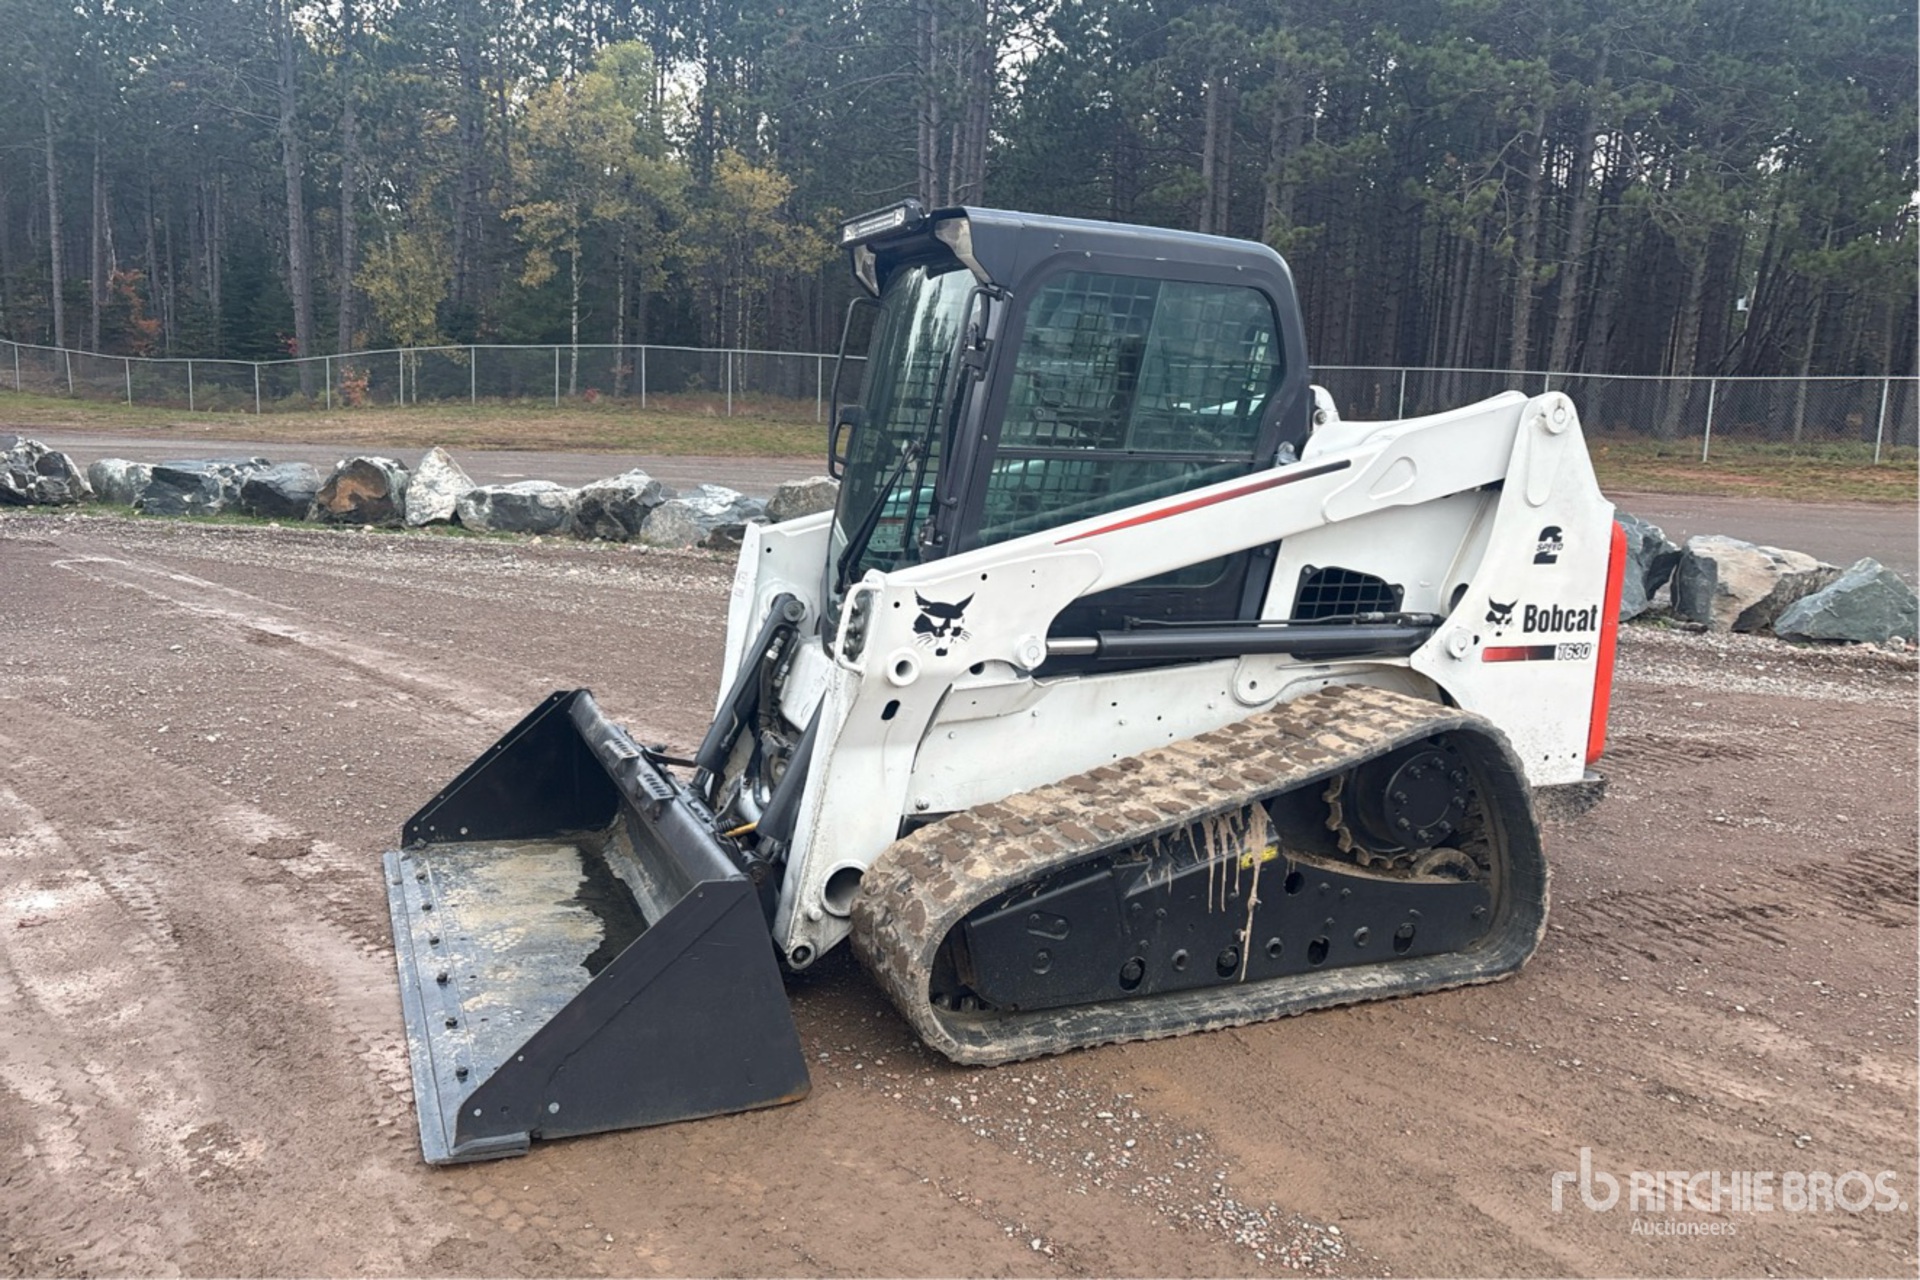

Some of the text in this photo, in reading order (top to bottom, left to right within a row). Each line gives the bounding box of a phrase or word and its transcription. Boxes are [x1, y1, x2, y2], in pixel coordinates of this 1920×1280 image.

[1536, 542, 1563, 551] SPEED
[1523, 604, 1597, 633] Bobcat
[1557, 642, 1592, 660] T630
